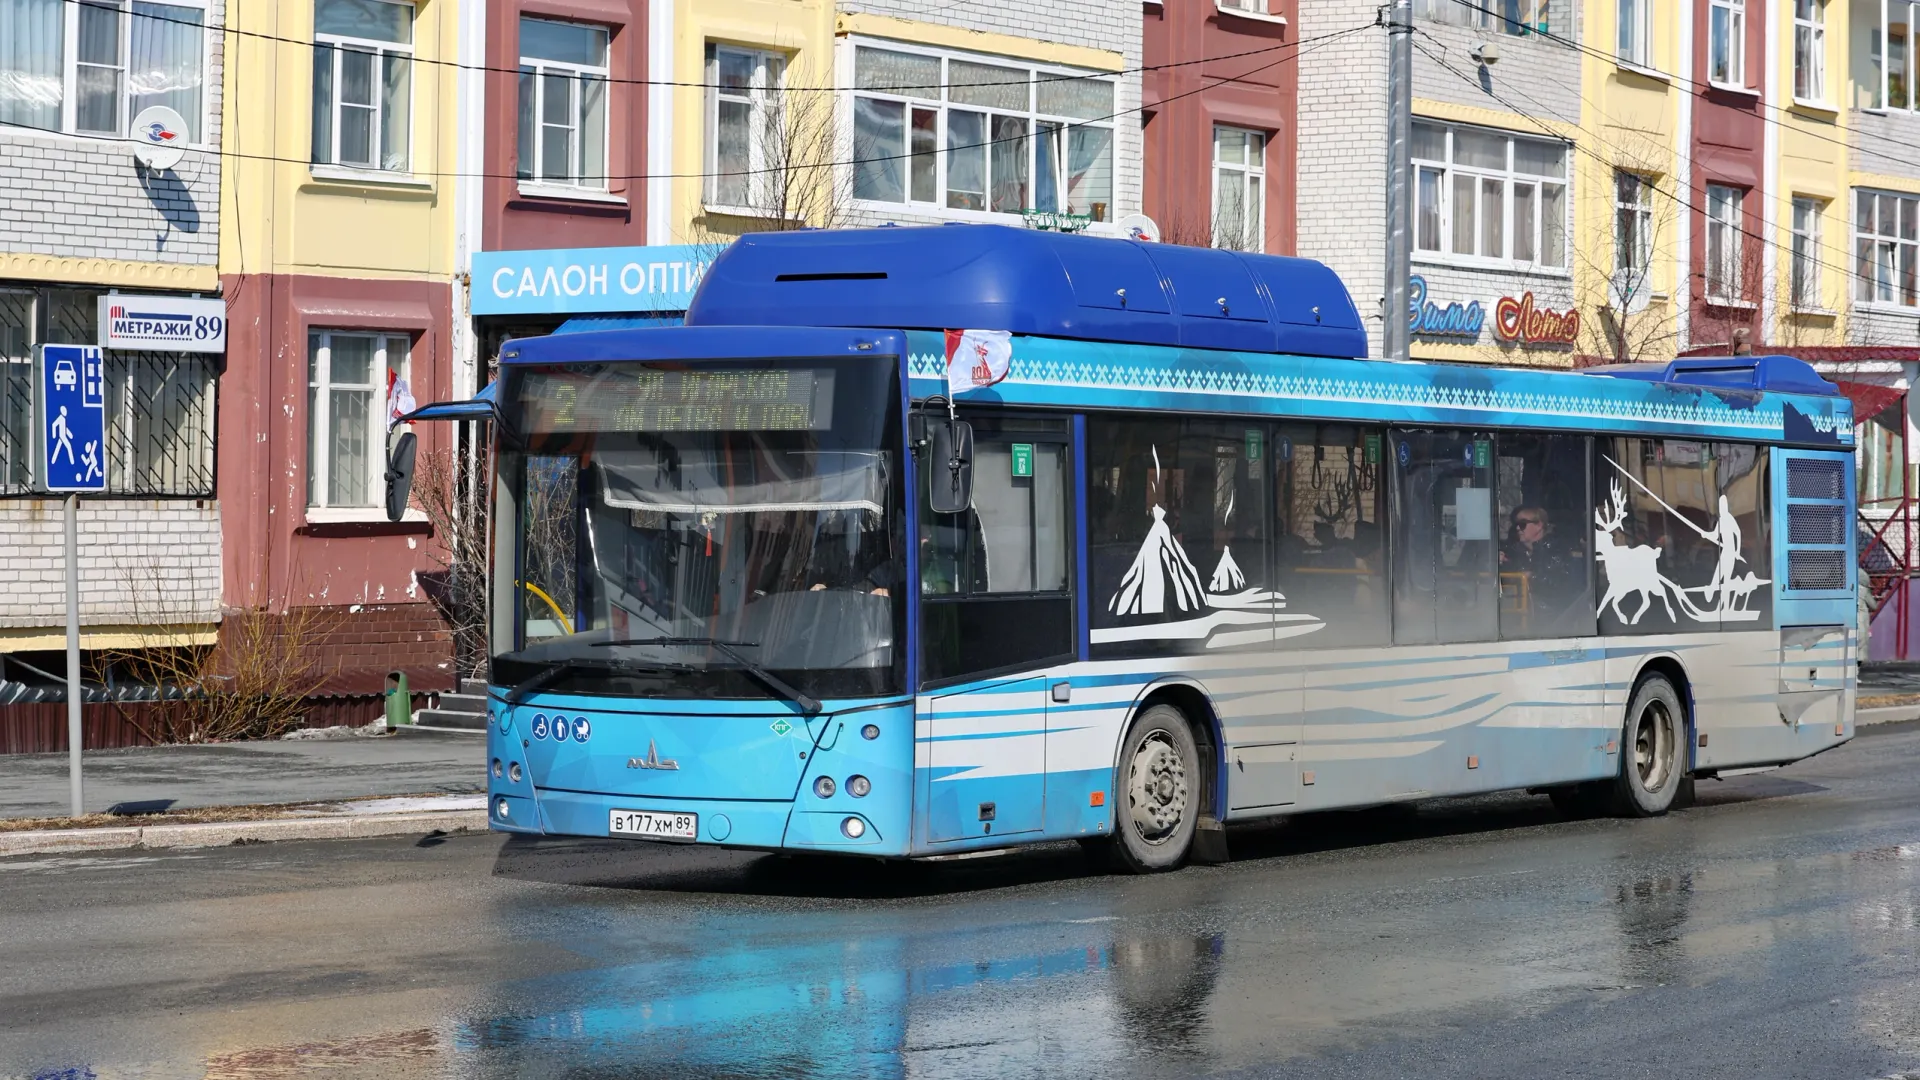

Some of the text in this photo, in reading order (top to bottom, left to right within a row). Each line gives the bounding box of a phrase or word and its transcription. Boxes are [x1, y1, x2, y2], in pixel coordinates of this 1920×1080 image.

[491, 261, 711, 300] САЛОН ОПТИ
[113, 316, 222, 341] МЕТРАЖИ 89
[1496, 291, 1580, 343] Лето
[553, 384, 577, 424] 2
[676, 816, 691, 830] 89
